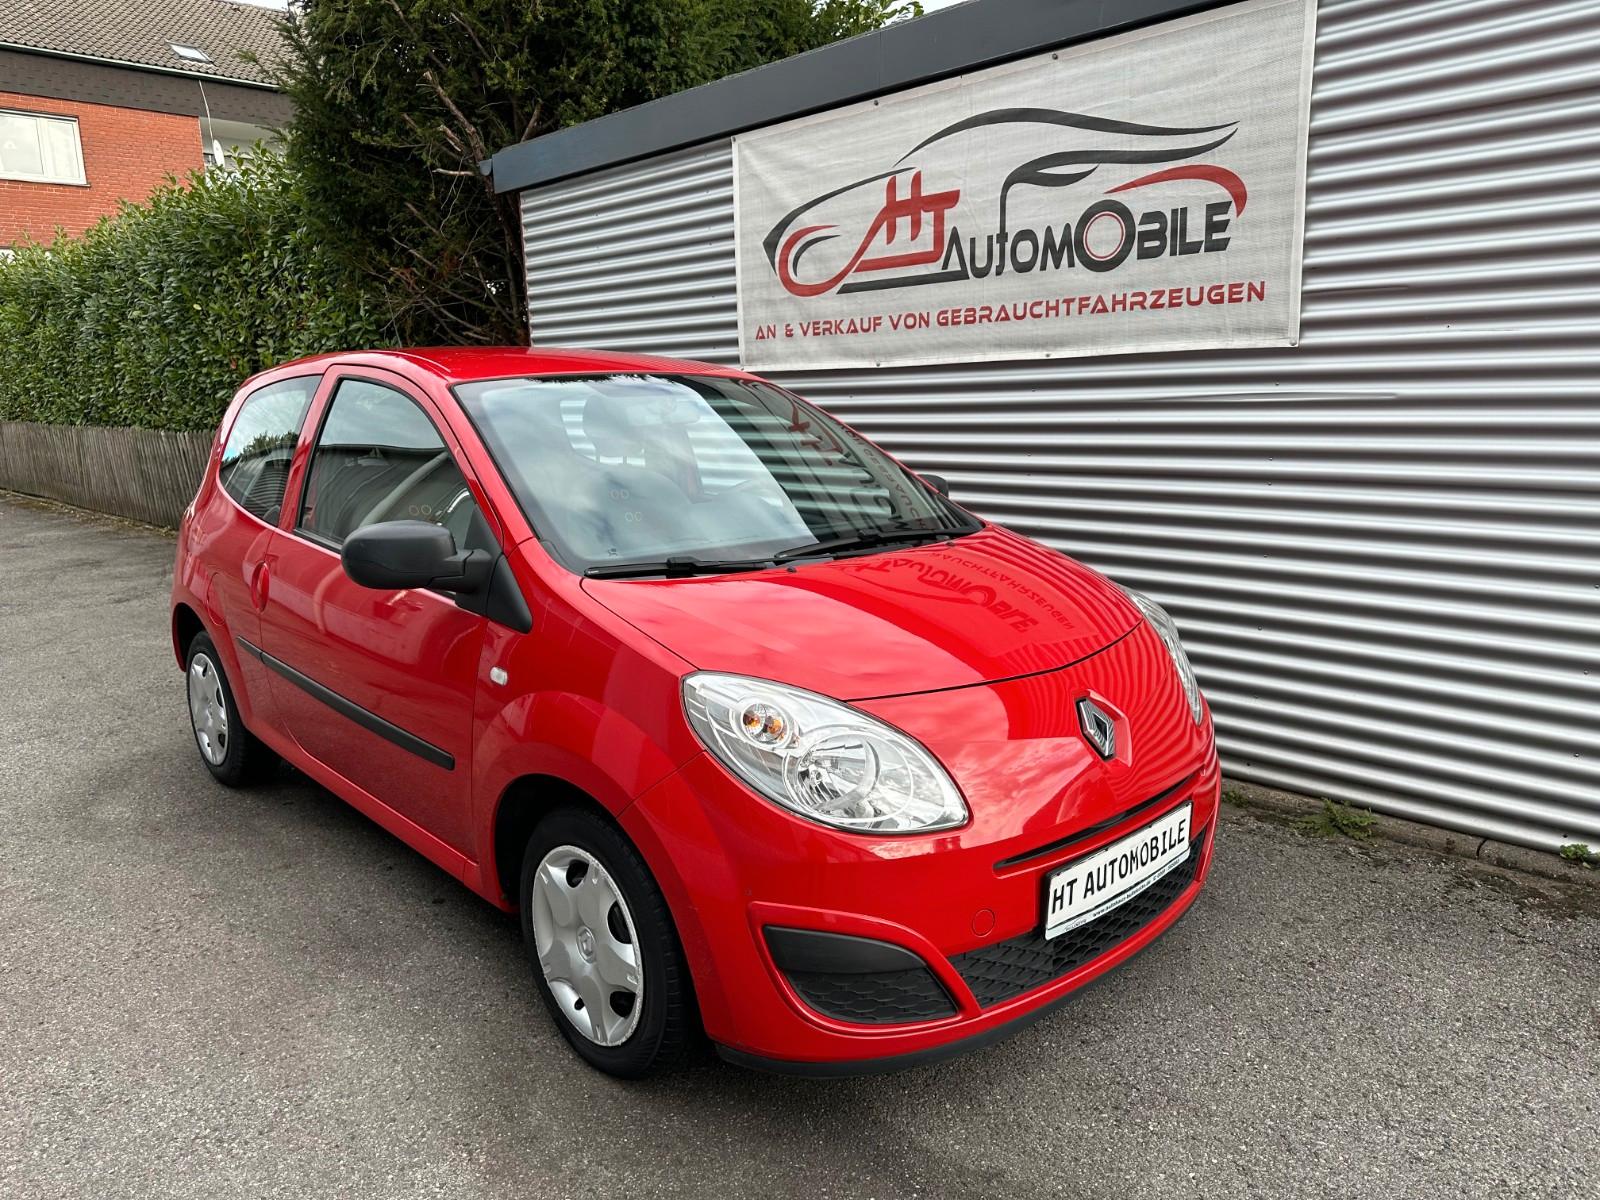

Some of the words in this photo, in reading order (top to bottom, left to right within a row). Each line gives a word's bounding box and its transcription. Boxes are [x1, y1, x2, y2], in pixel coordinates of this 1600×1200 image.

[941, 199, 1233, 280] AUTOMOBILE
[755, 326, 777, 340] AN
[784, 326, 794, 338] &
[799, 315, 882, 338] VERKAUF
[888, 311, 931, 330] VON
[936, 281, 1266, 327] GEBRAUCHTFAHRZEUGEN
[1051, 877, 1078, 915] HT
[1083, 818, 1186, 899] AUTOMOBILE
